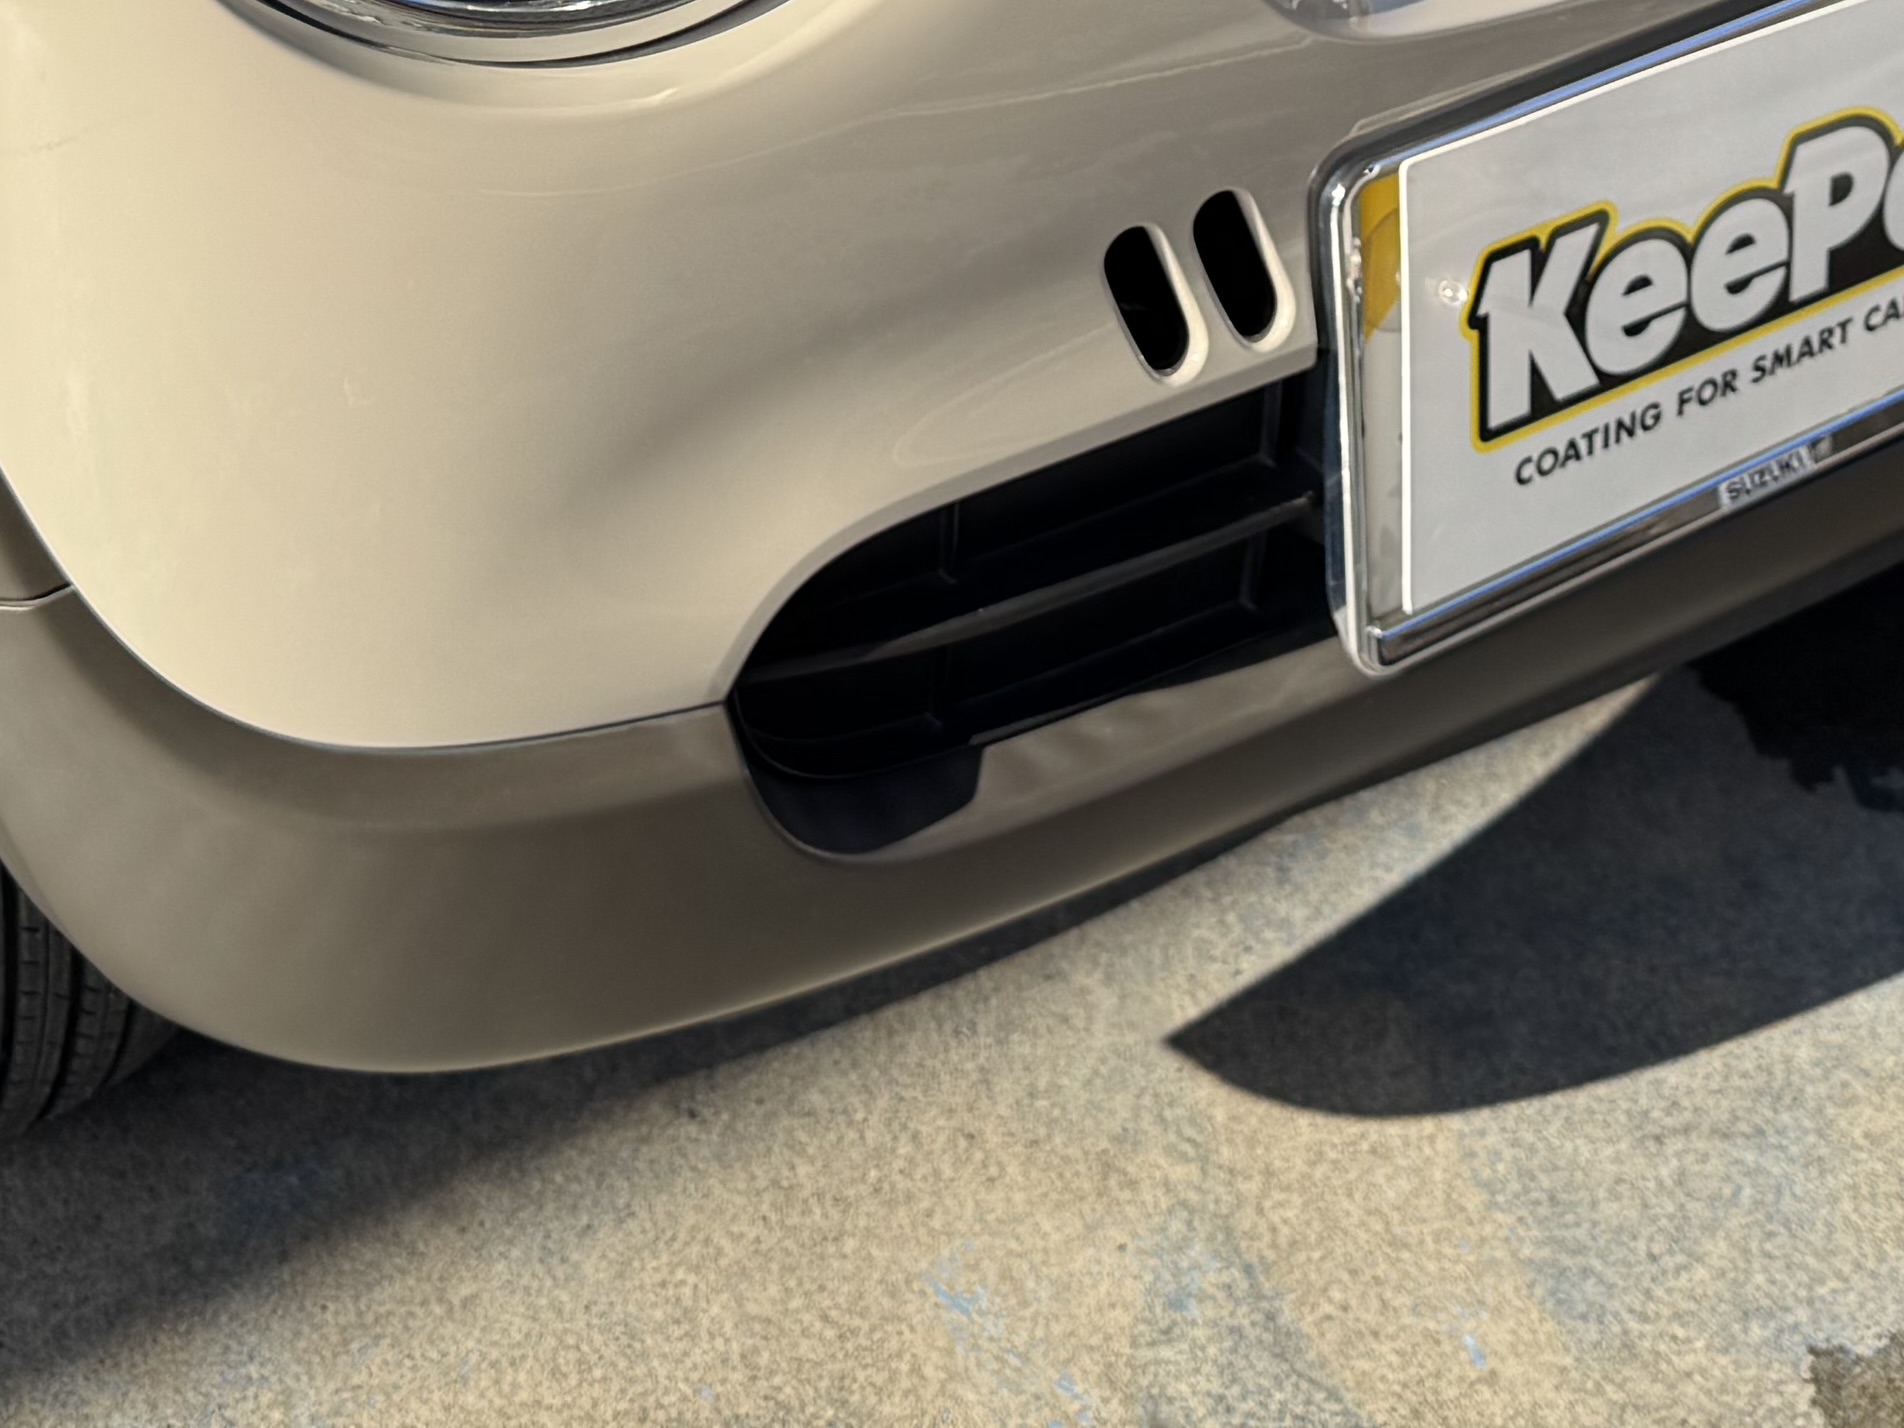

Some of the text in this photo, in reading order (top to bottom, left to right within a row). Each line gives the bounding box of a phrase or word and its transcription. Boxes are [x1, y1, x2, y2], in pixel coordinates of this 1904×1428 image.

[1514, 401, 1662, 486] COATING
[1676, 370, 1740, 417] FOR
[1749, 318, 1853, 384] SMART
[1726, 449, 1806, 499] SUZUKI
